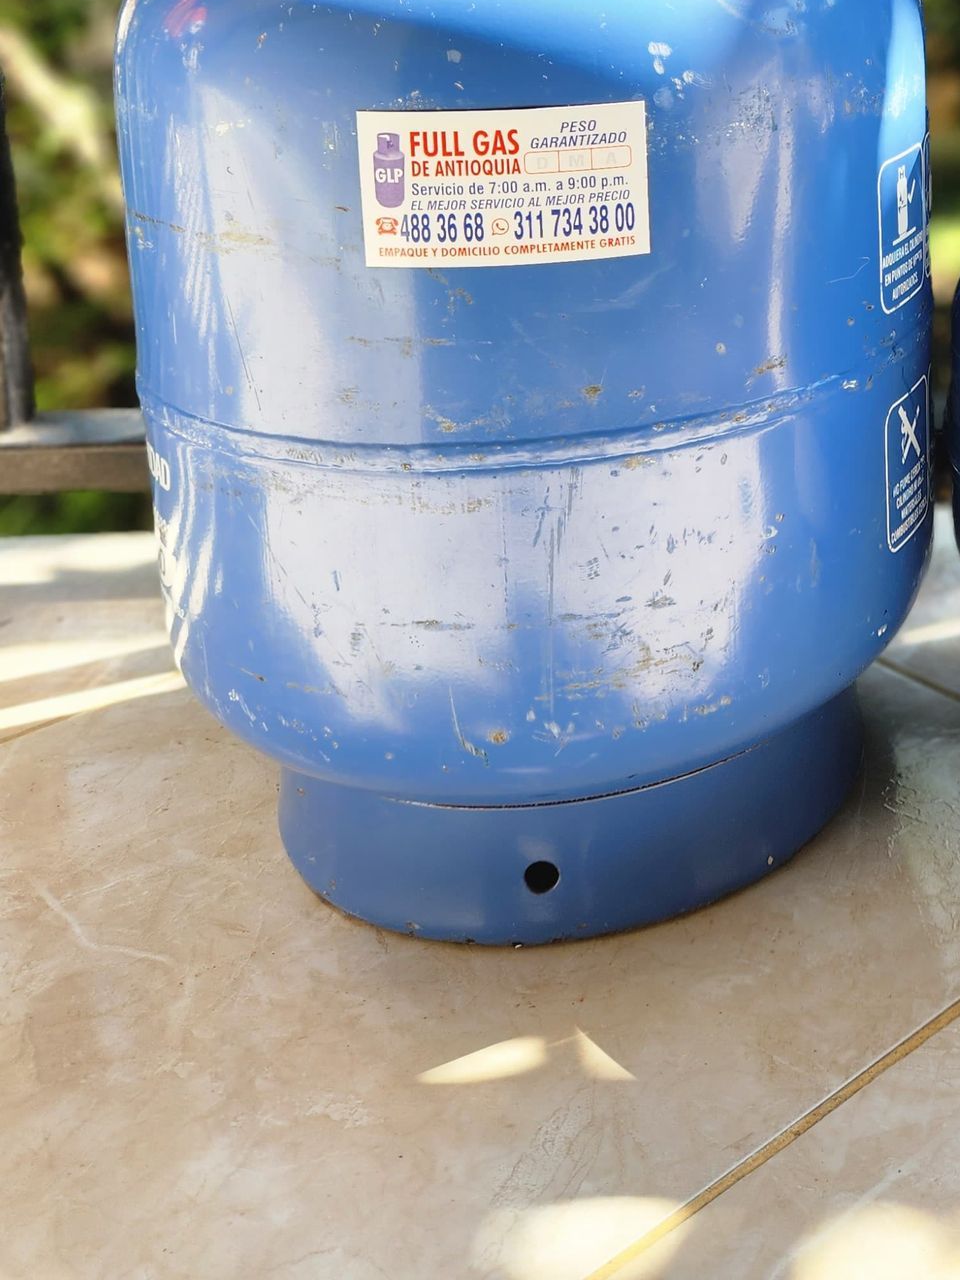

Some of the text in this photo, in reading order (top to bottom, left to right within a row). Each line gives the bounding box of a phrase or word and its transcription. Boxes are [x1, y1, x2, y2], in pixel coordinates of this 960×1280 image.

[560, 120, 597, 133] PESO
[410, 129, 519, 157] FULL GAS
[530, 132, 627, 149] GARANTIZADO
[412, 158, 521, 177] DE ANTIOQUIA
[537, 152, 617, 169] D M A
[375, 168, 403, 184] GLP
[411, 175, 628, 196] Servicio de 7:00 a.m. a 9:00 p.m.
[411, 190, 630, 211] EL MEJOR SERVICIO AL MEJOR PRECIO
[400, 213, 484, 242] 488 36 68
[513, 202, 635, 240] 311 734 38 00
[379, 236, 635, 258] EMPAQUE Y DOMICILIO COMPLETAMENTE GRATIS
